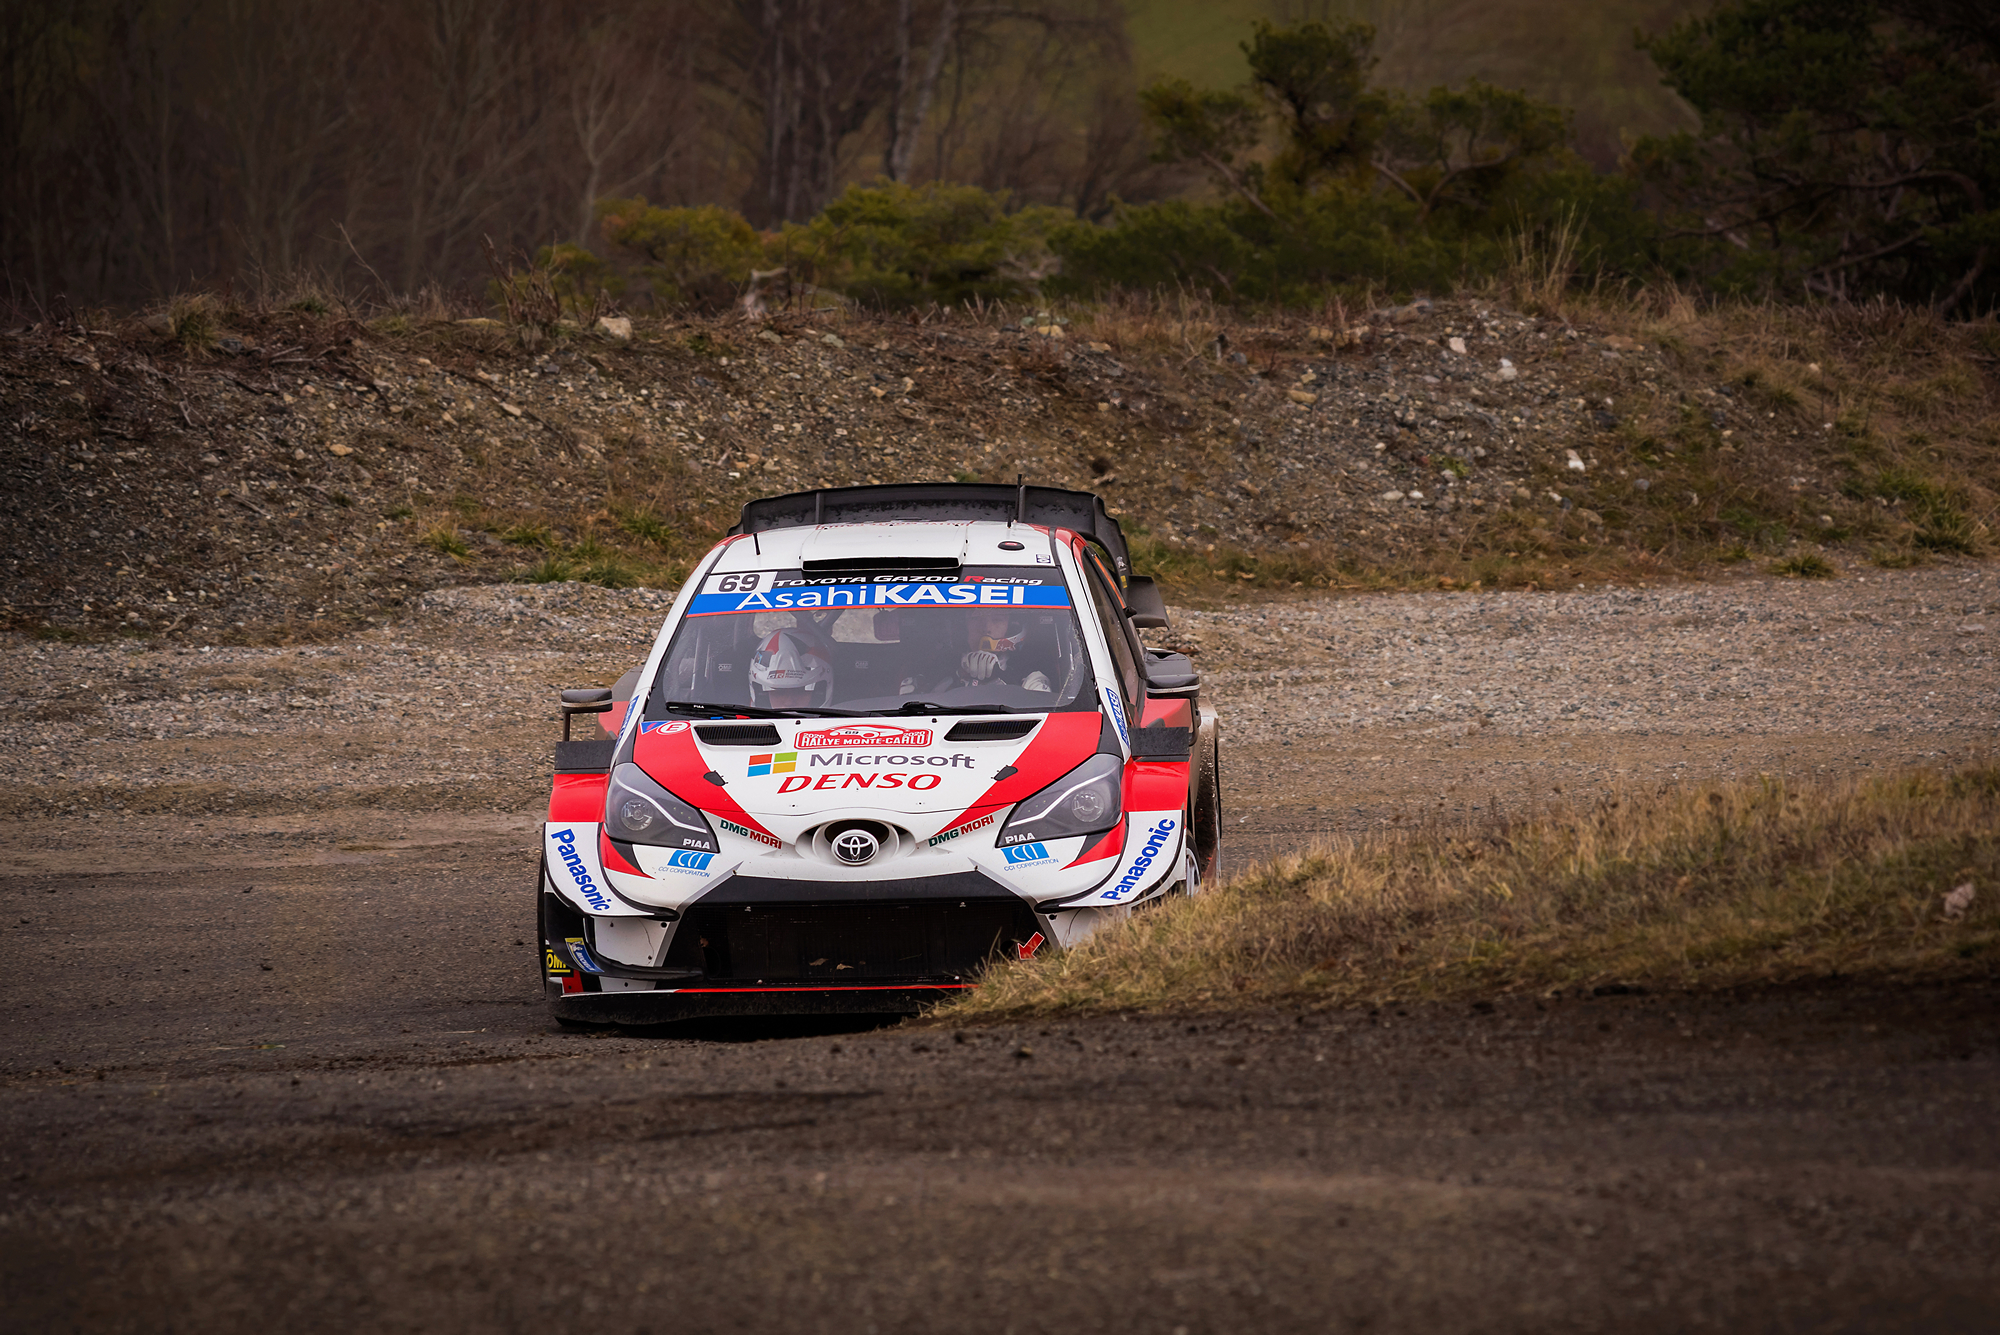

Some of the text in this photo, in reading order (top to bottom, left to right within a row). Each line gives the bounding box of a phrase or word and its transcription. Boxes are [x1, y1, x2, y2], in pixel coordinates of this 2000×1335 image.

[718, 573, 761, 592] 69
[774, 575, 1043, 587] TOYOTA GAZOO Racing
[801, 735, 925, 747] RALLYE MONTE-CARLO
[809, 753, 975, 769] Microsoft
[776, 773, 942, 794] DENSO
[720, 819, 783, 849] DMG MORI
[927, 814, 995, 847] DMG MORI
[1004, 832, 1036, 844] PIAA
[682, 838, 711, 849] PIAA
[1003, 858, 1059, 872] CCI CORPORATION
[1100, 818, 1176, 900] Panasonic
[551, 828, 612, 911] Panasonic
[670, 868, 711, 878] CORPORATION
